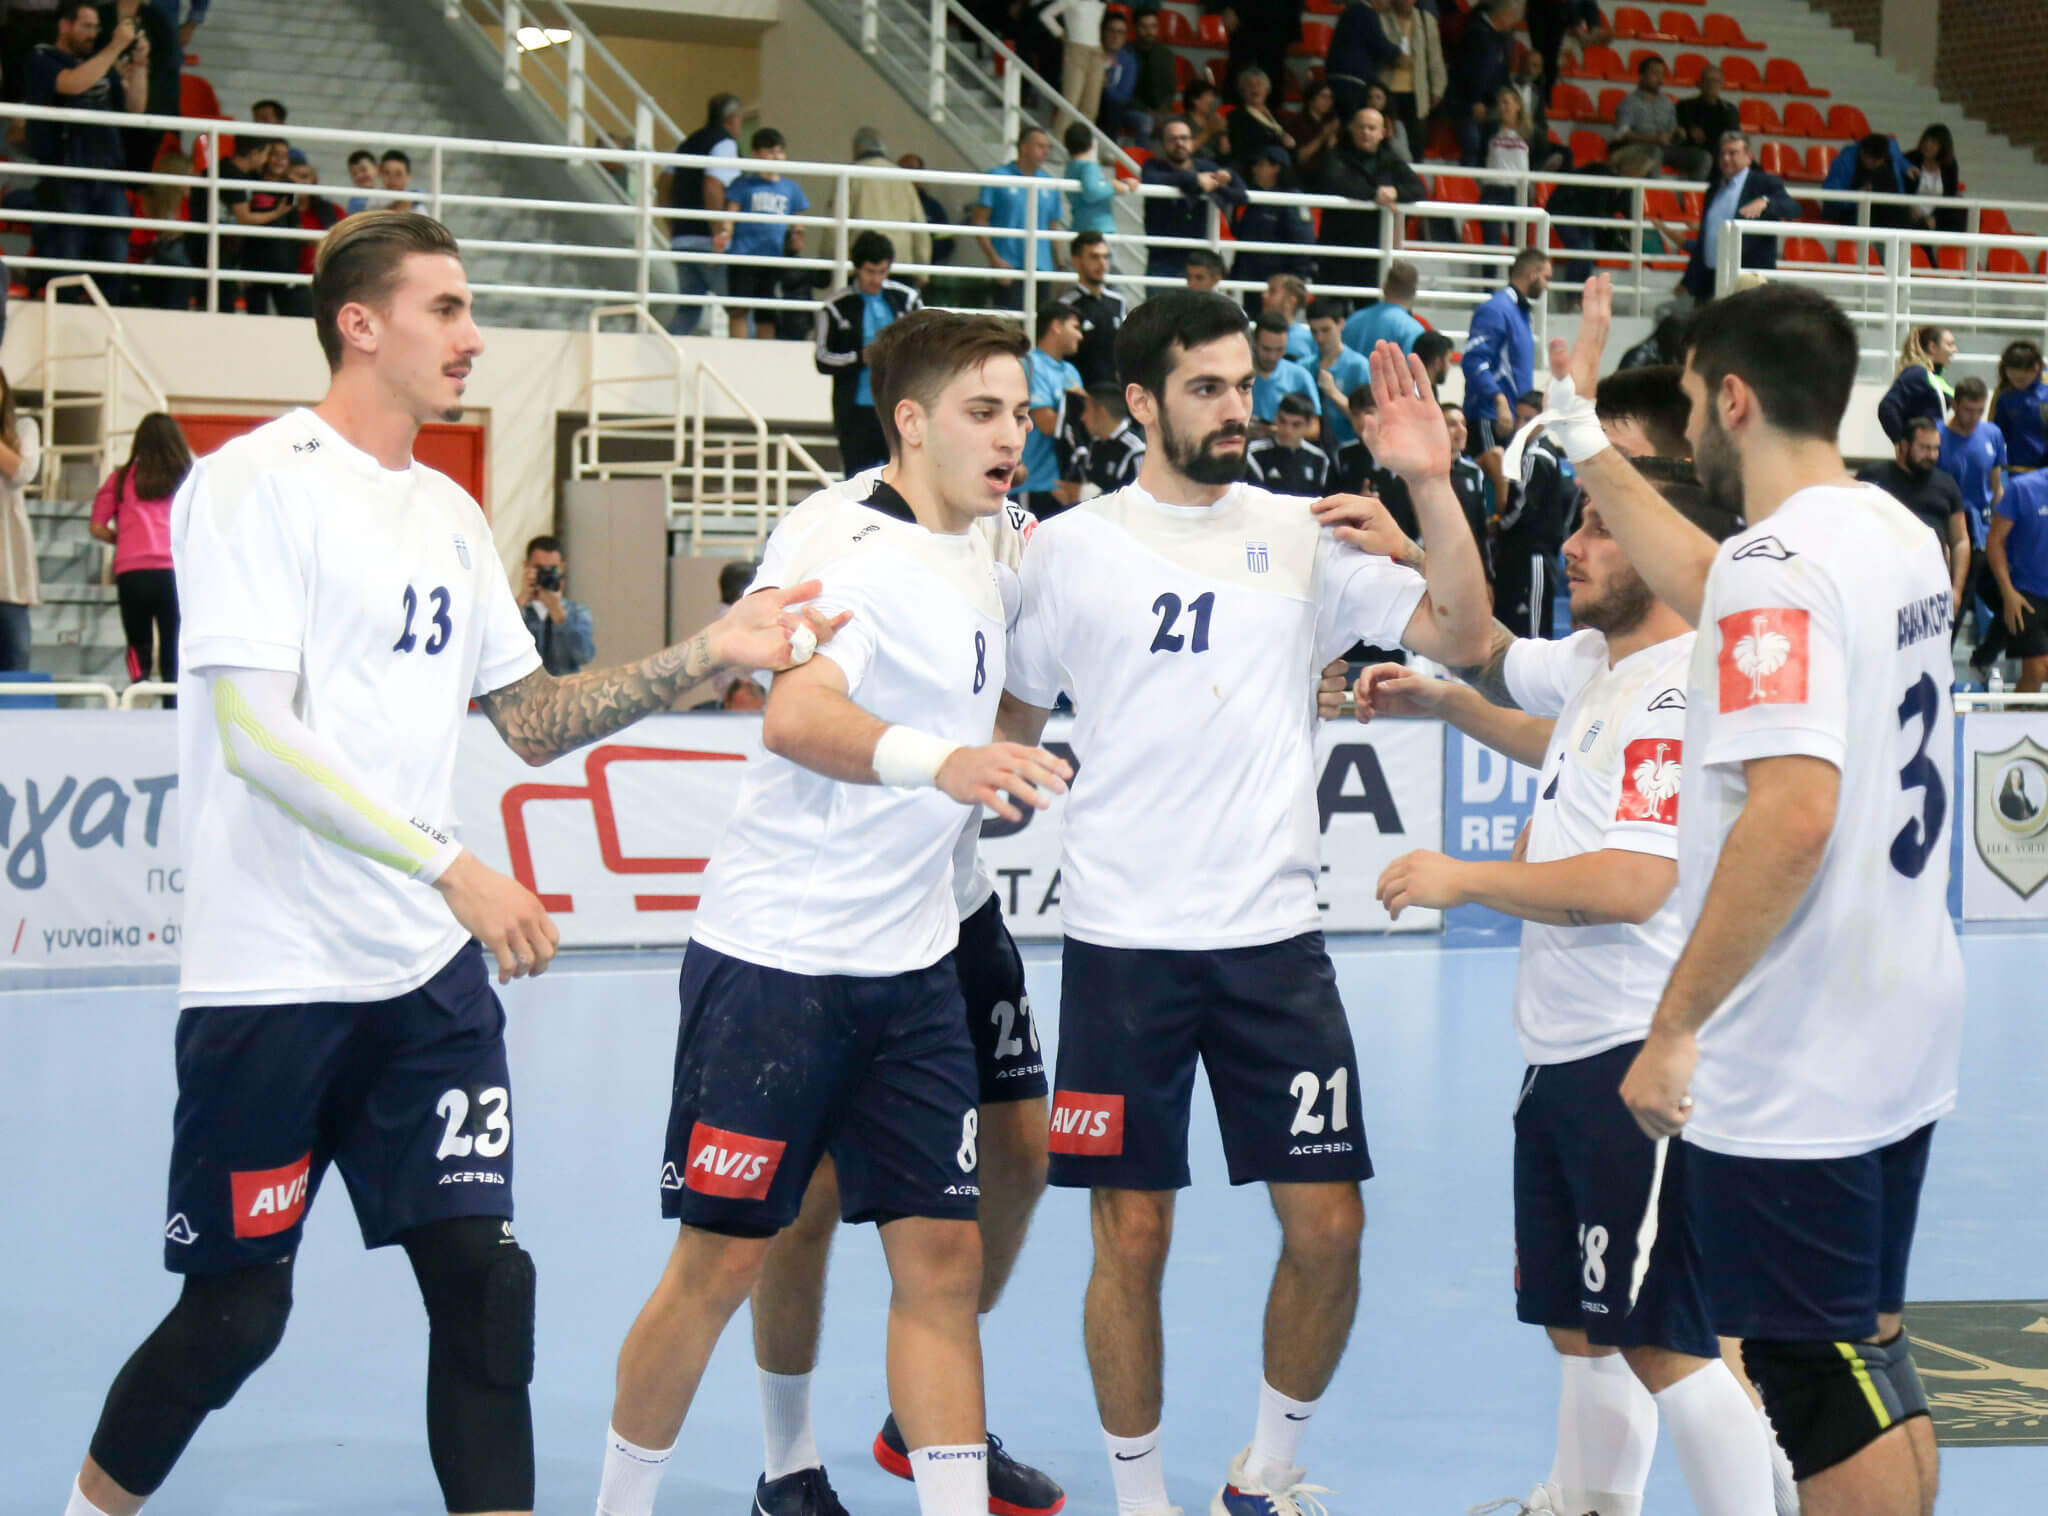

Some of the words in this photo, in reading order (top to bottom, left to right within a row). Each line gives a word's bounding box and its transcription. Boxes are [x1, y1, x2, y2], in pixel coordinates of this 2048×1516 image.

[393, 584, 453, 656] 23
[1150, 591, 1216, 654] 21
[973, 630, 986, 695] 8
[436, 1087, 510, 1161] 23
[1050, 1106, 1110, 1137] AVIS
[1290, 1066, 1349, 1136] 21
[692, 1144, 768, 1182] AVIS
[957, 1107, 978, 1173] 8
[1289, 1142, 1352, 1155] ACERBIS
[439, 1172, 505, 1185] ACERBIS
